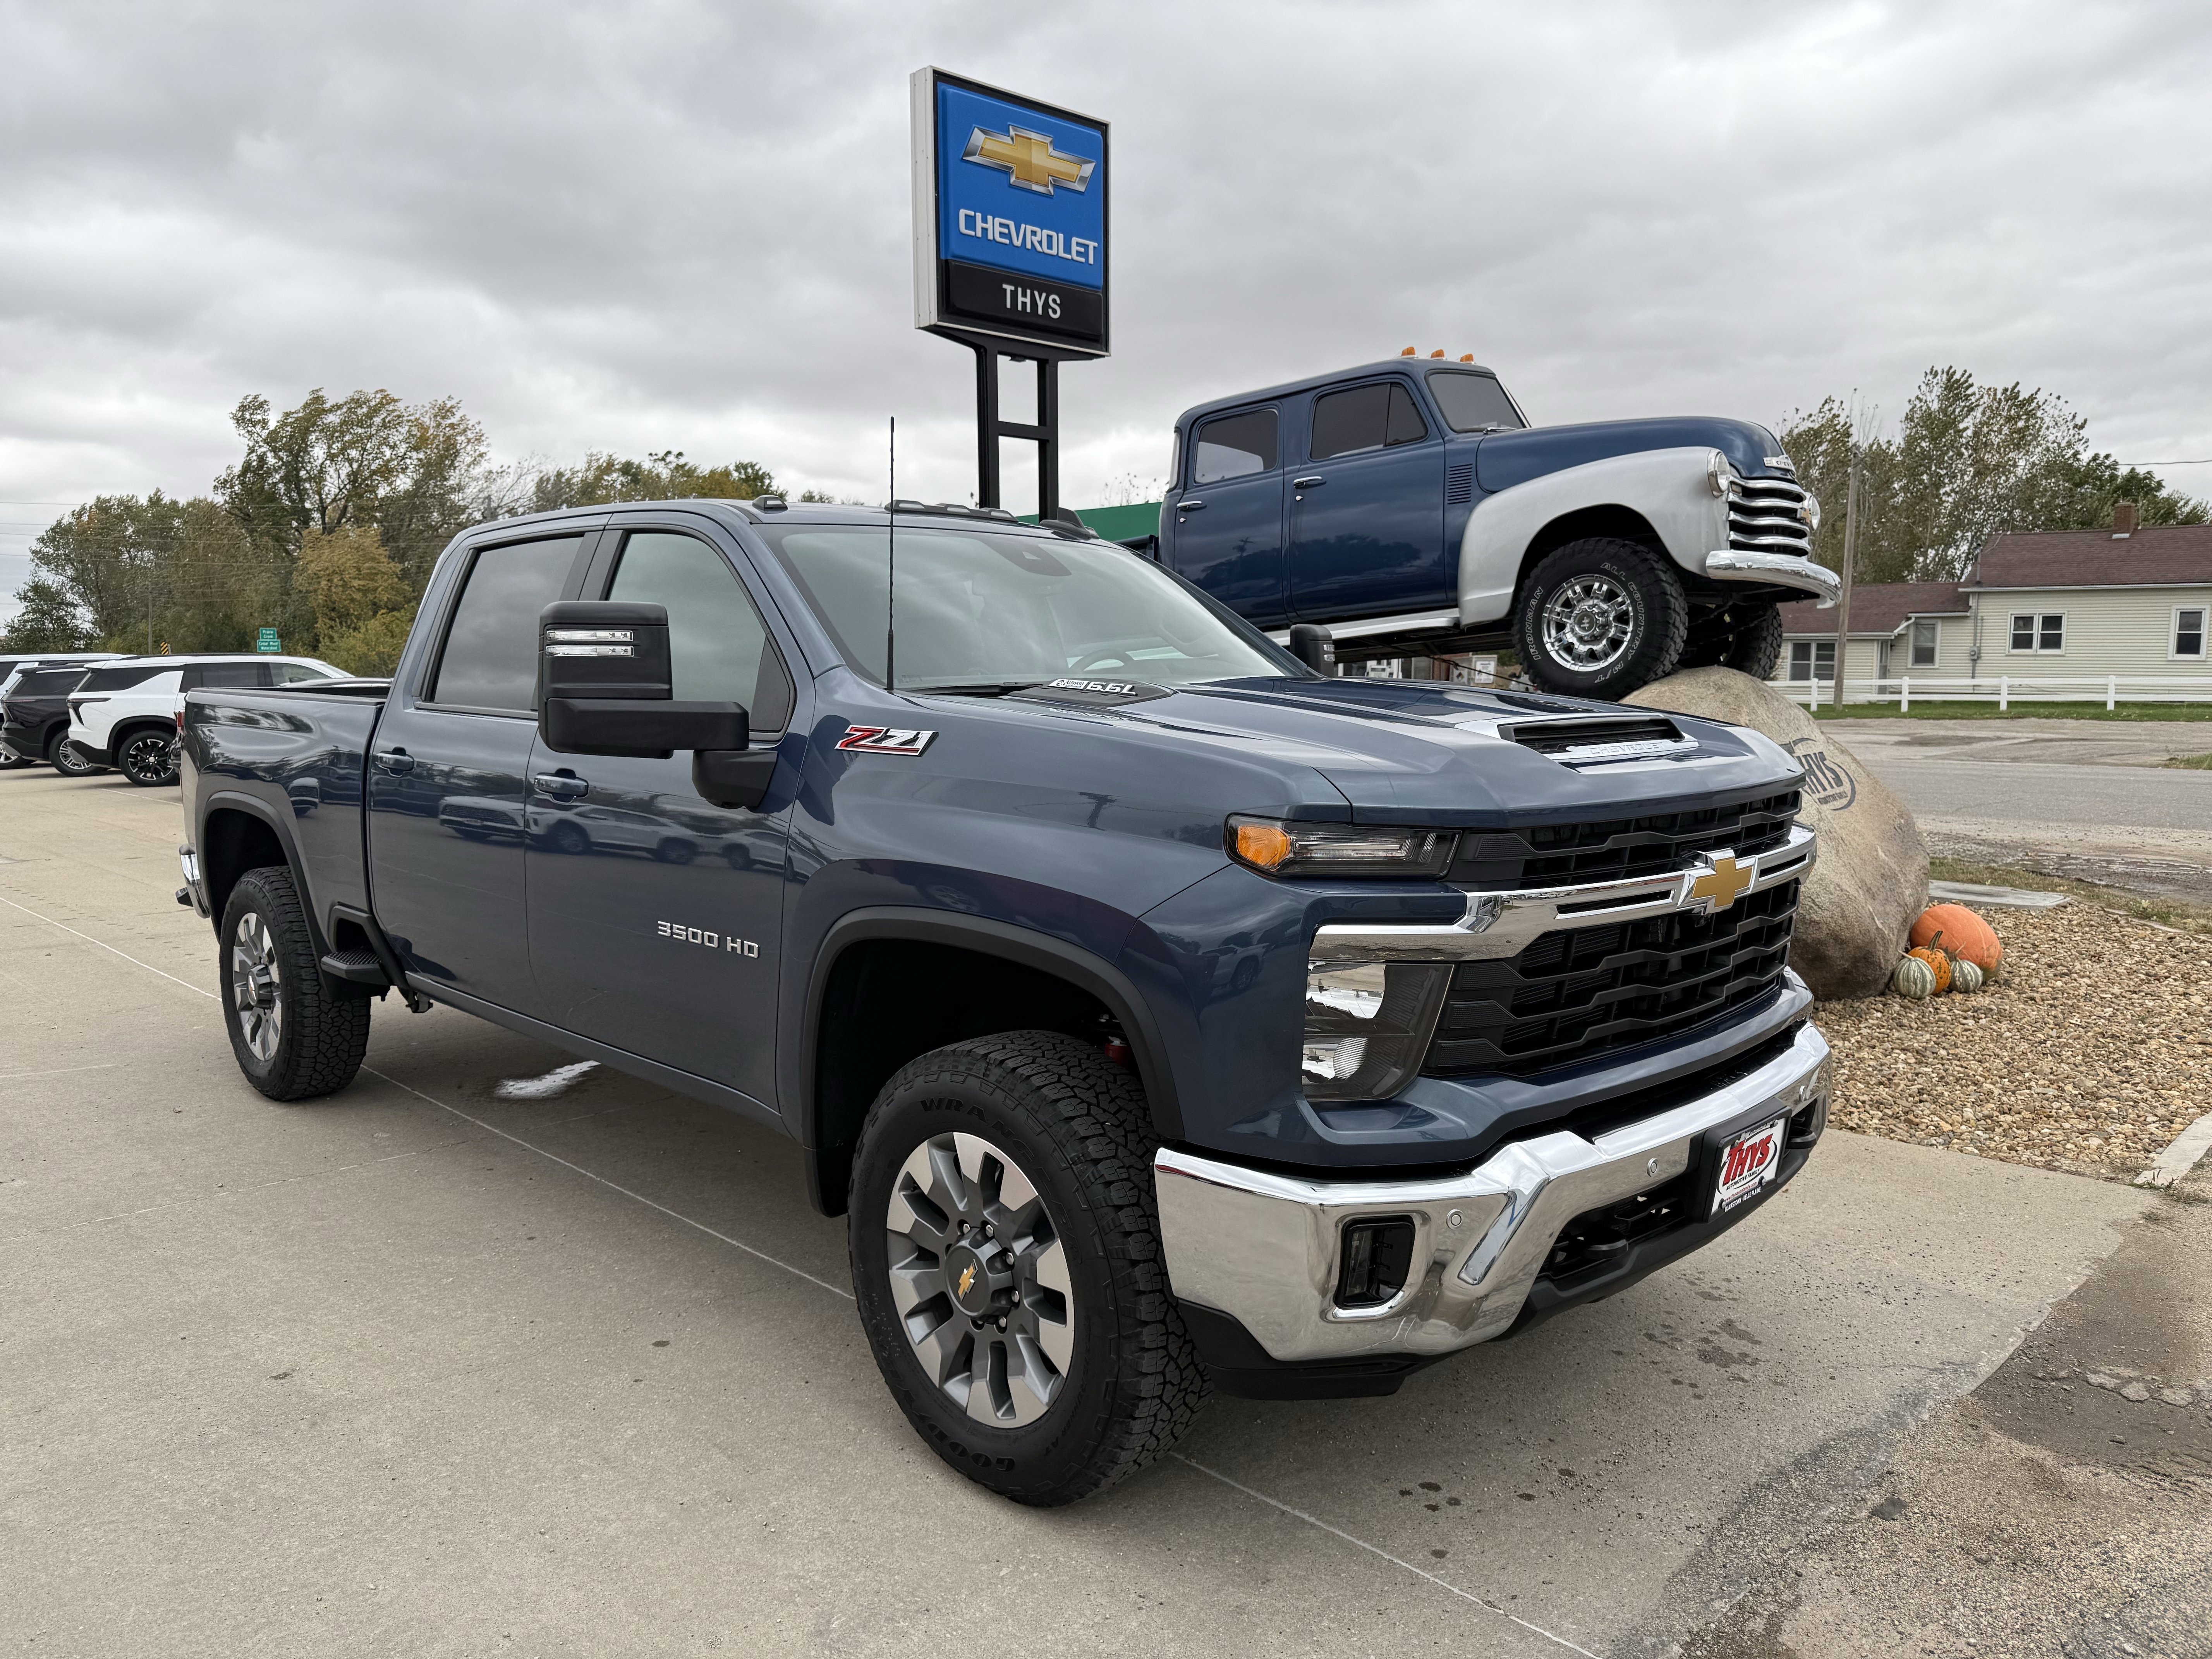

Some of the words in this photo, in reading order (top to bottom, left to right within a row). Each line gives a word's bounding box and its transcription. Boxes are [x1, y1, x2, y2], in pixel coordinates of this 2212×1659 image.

[959, 209, 1098, 265] CHEVROLET
[1002, 283, 1061, 319] THYS
[1600, 562, 1626, 580] ALL
[1525, 586, 1543, 661] IRONMAN
[1628, 582, 1645, 660] COUNTRY
[1085, 682, 1138, 696] 6.6L
[1594, 661, 1624, 684] M/T
[835, 724, 939, 757] Z71
[1589, 742, 1664, 754] CHEVROLET
[658, 921, 720, 948] 3500
[726, 936, 759, 958] HD
[1722, 1133, 1774, 1187] THYS
[920, 1097, 1084, 1265] WRANGLER
